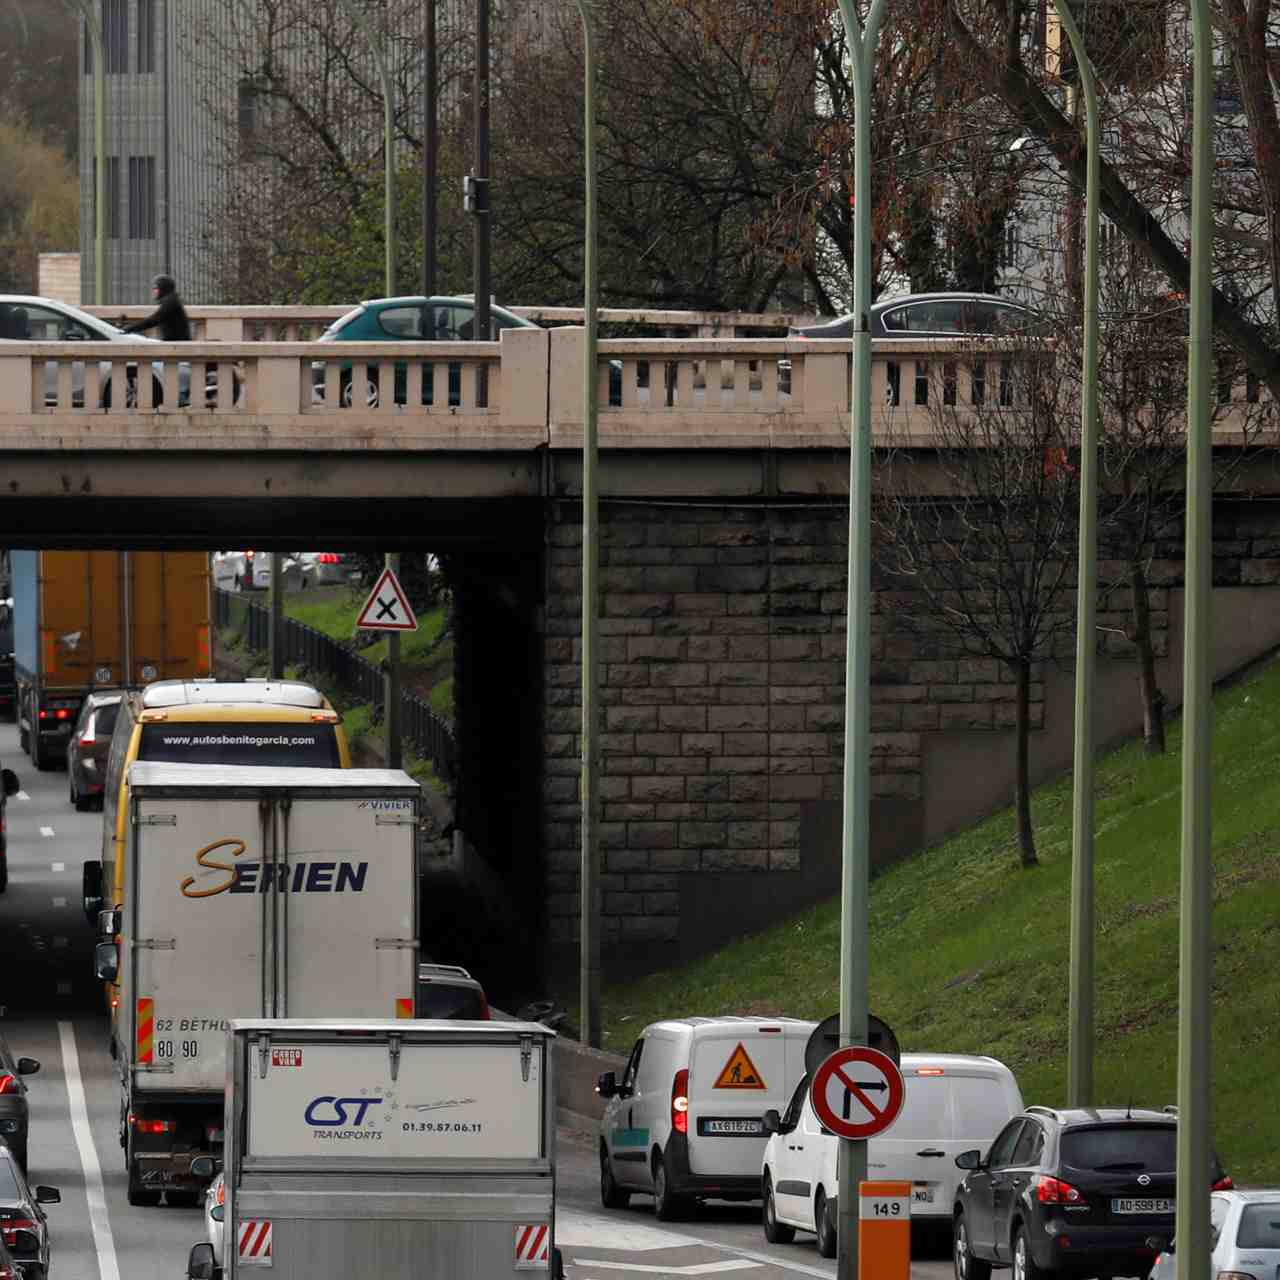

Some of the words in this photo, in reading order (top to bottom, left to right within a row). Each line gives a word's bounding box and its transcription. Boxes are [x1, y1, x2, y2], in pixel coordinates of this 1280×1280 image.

[181, 837, 369, 898] SERIEN
[156, 1018, 177, 1032] 62
[158, 1039, 173, 1058] 80
[182, 1039, 198, 1058] 90
[304, 1096, 383, 1127] CST
[312, 1130, 384, 1141] TRANSPORTS
[873, 1202, 900, 1216] 149
